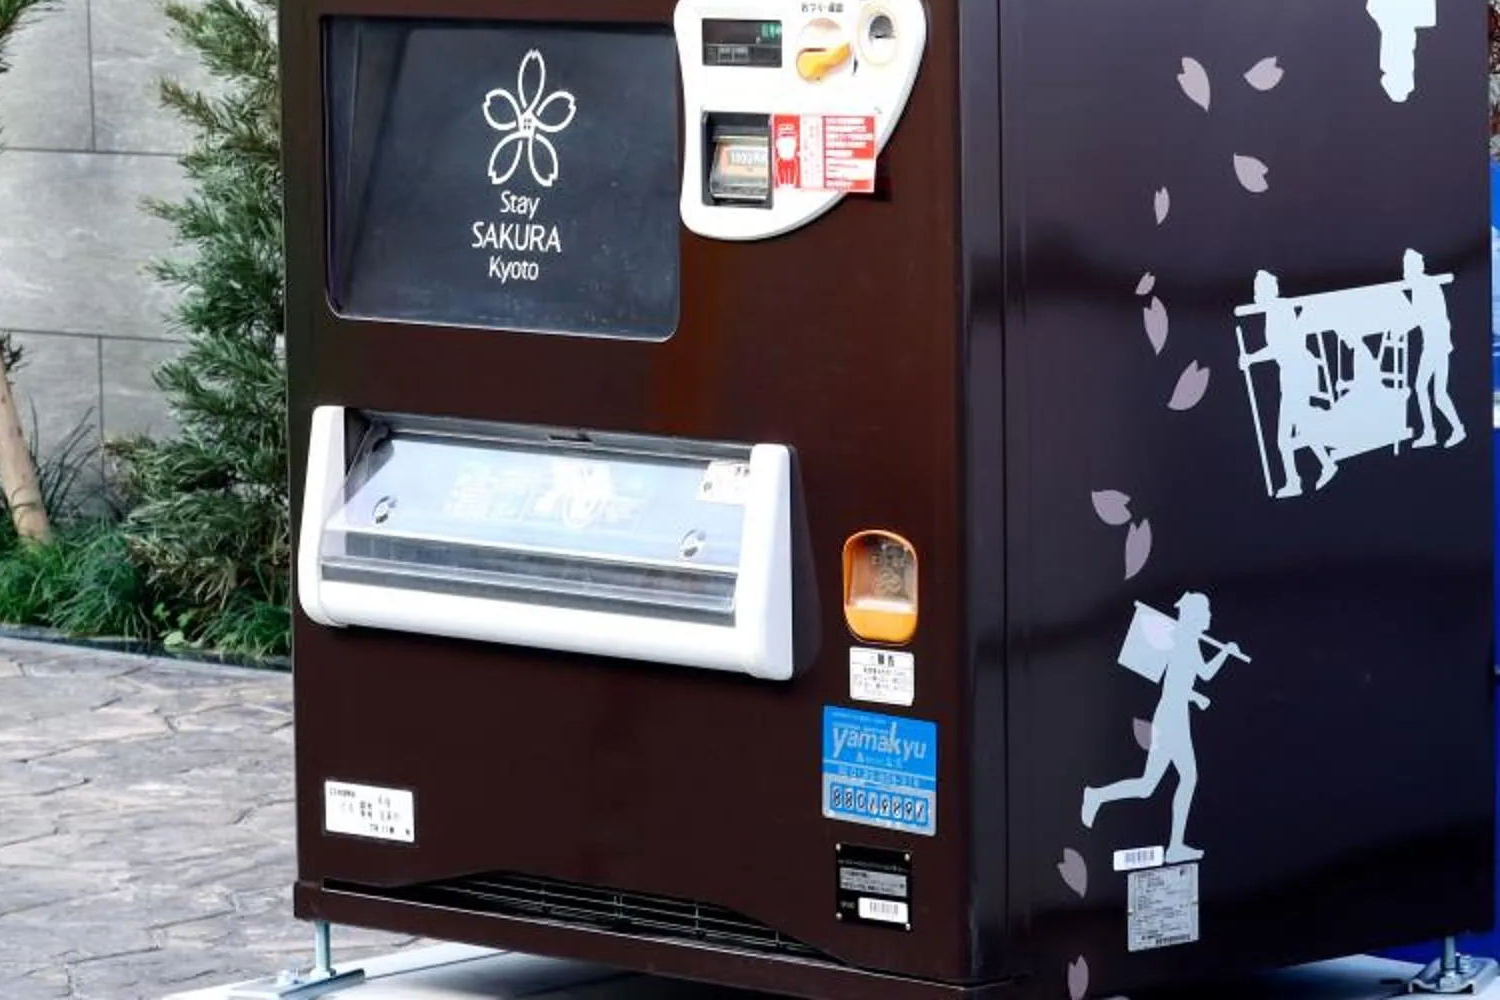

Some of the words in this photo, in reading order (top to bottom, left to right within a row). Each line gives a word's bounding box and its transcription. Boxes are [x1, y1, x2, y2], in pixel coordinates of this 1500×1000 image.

[500, 190, 541, 219] Stay
[471, 221, 562, 253] SAKURA
[488, 255, 540, 284] Kyoto
[832, 721, 927, 760] yamakyu
